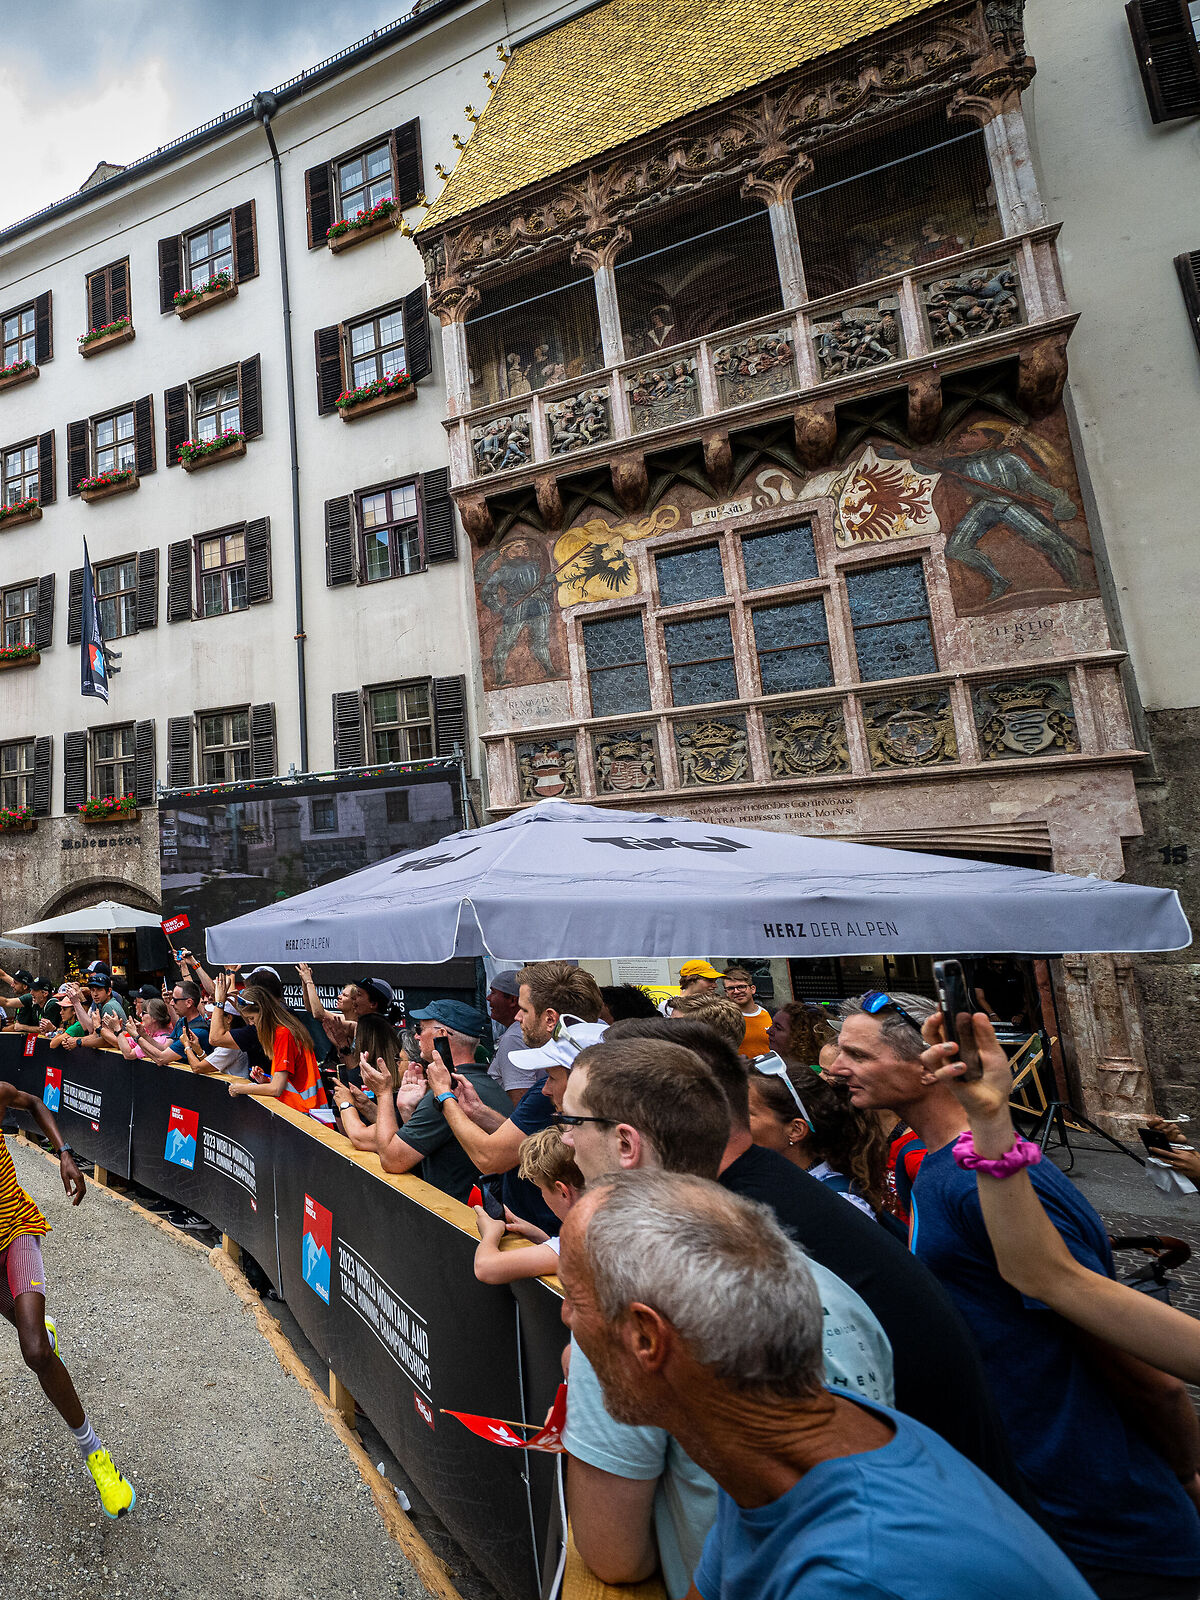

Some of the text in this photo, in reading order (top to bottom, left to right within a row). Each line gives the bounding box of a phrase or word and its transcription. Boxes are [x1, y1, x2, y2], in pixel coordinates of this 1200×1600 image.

[583, 836, 753, 853] Tirol
[1158, 844, 1188, 864] 15
[763, 921, 899, 938] HERZ DER ALPEN
[285, 939, 299, 950] HERZ
[311, 936, 330, 949] ALPEN
[283, 985, 404, 1001] 2023 ORLD ND
[284, 997, 338, 1009] TRAIL NING
[202, 1131, 216, 1149] 2023
[216, 1137, 232, 1157] WORLD
[315, 1282, 329, 1301] stubai
[338, 1246, 429, 1360] 2023 WORLD MOUNTAIN AND
[340, 1270, 432, 1391] TRAIL RUNNING CHAMPIONSHIPS
